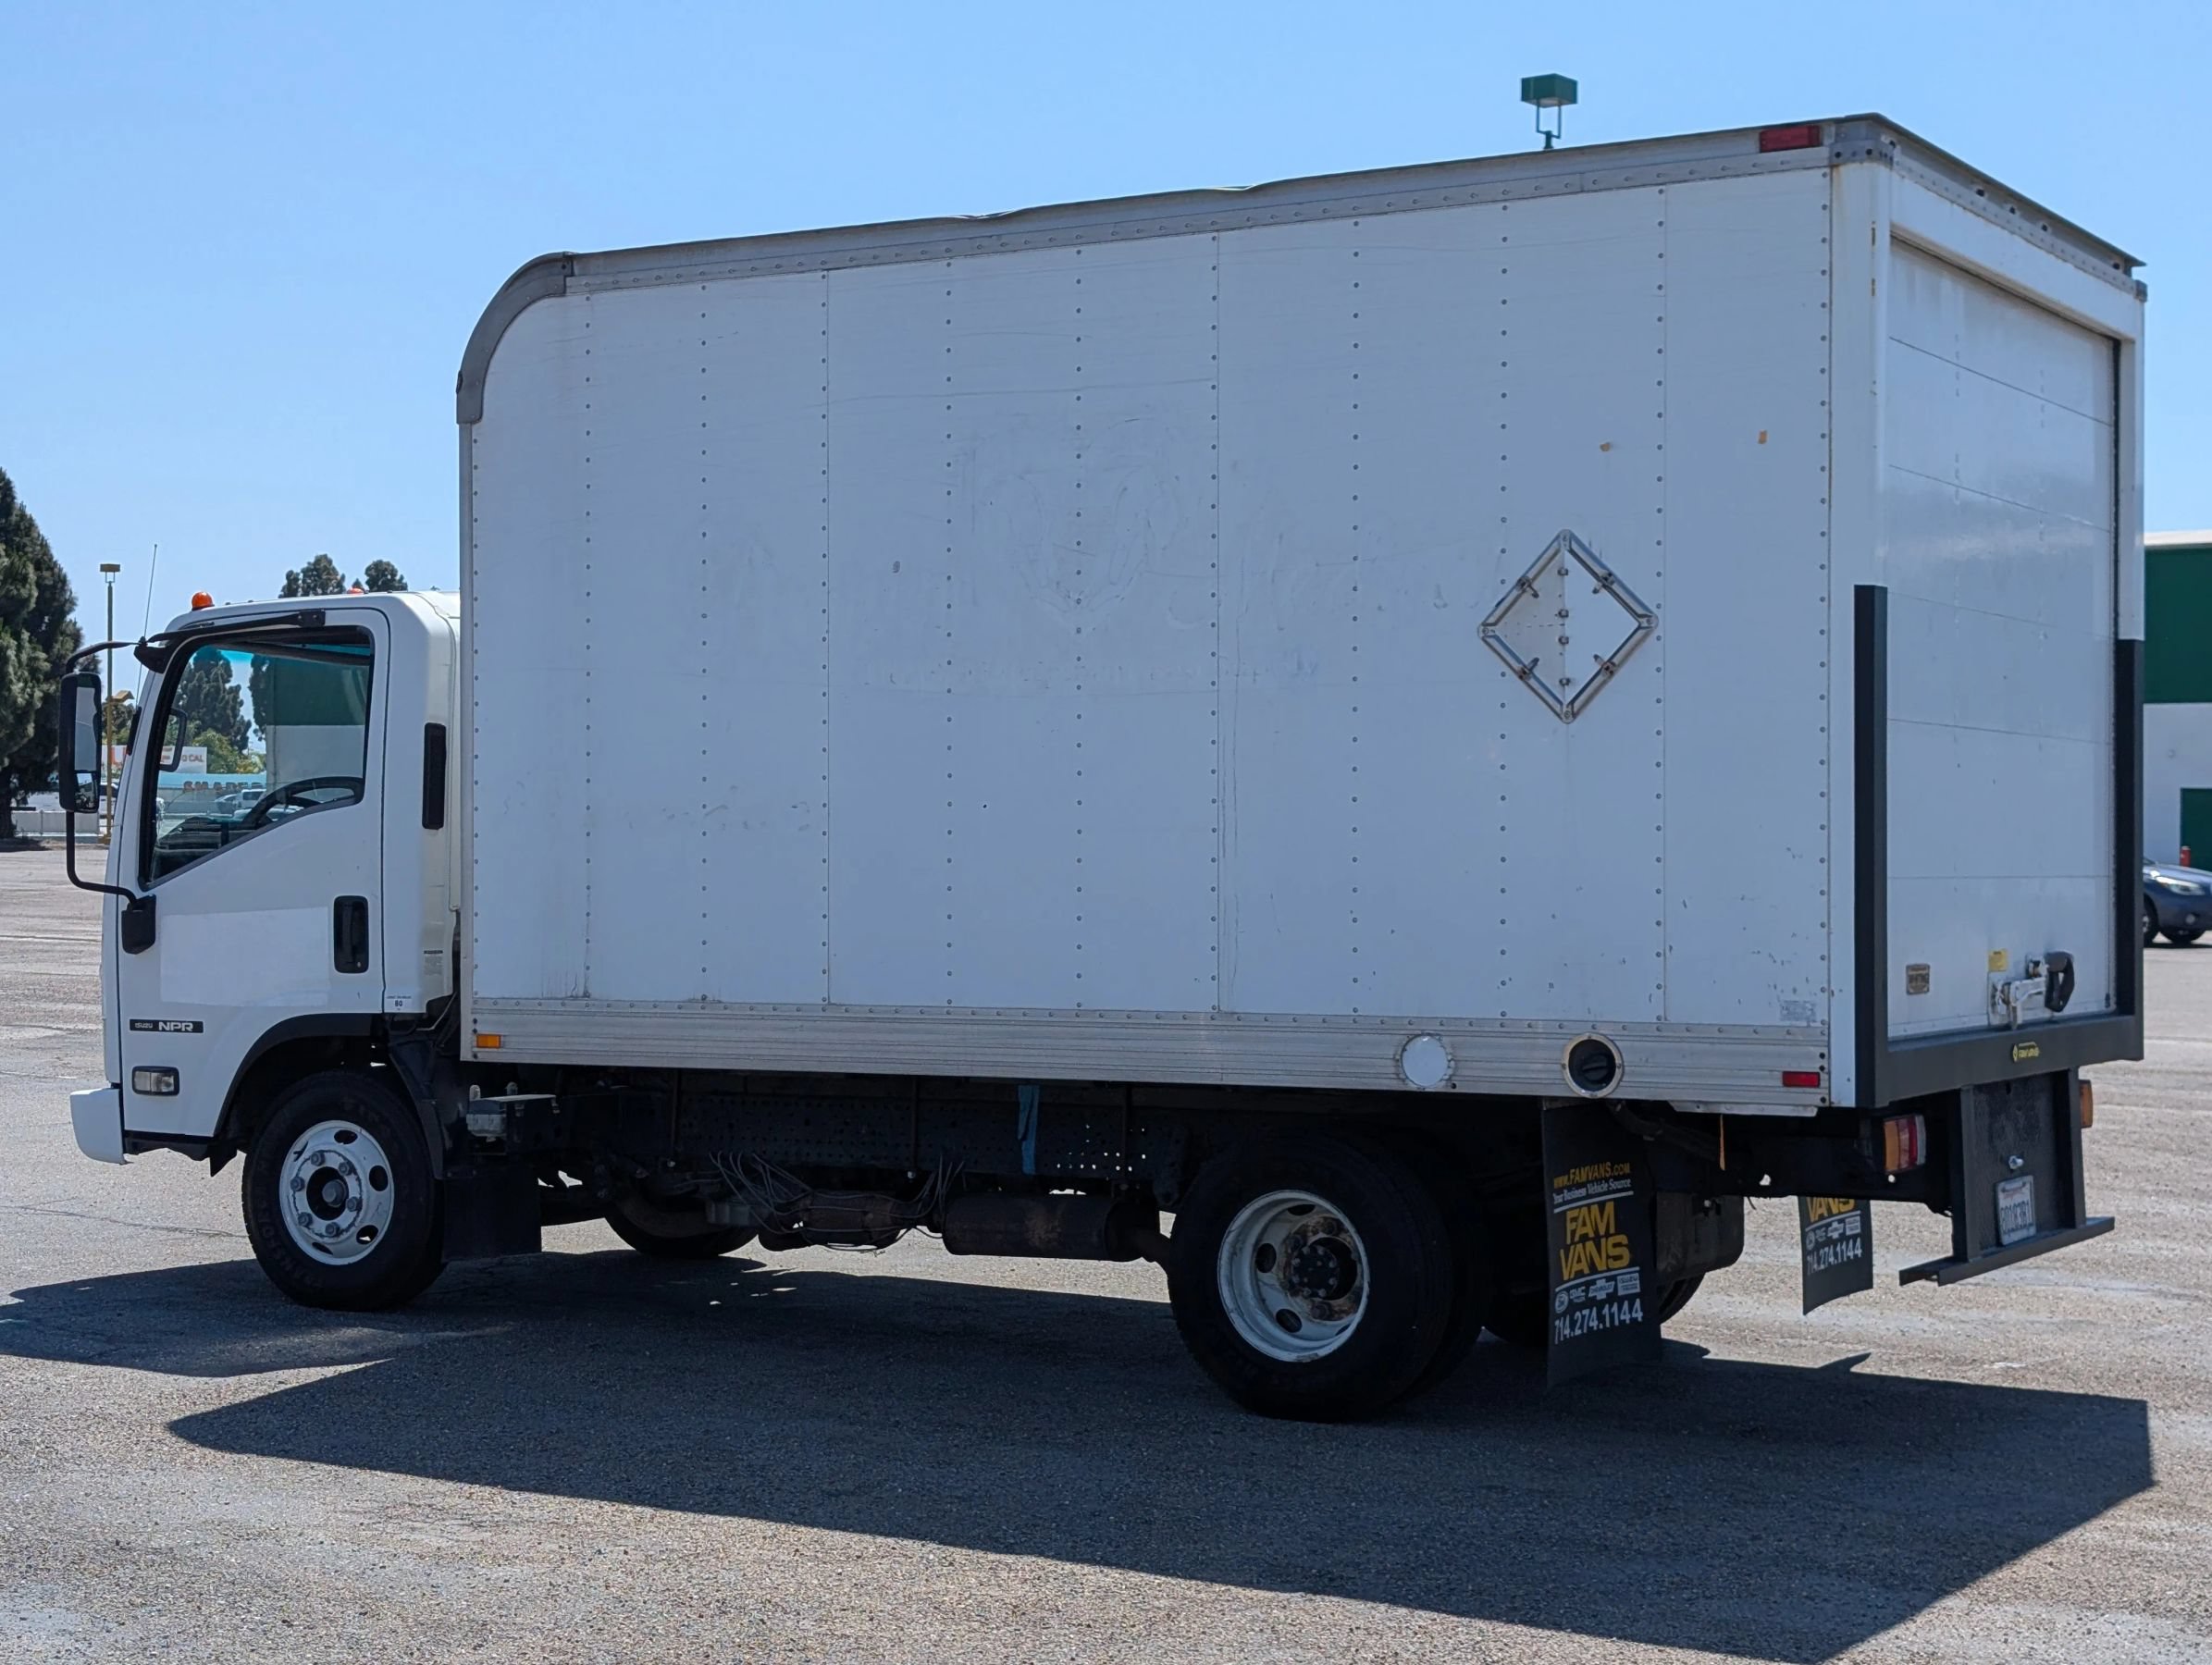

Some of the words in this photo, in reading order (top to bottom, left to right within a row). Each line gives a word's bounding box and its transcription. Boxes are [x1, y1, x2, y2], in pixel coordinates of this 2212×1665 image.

[158, 1021, 193, 1032] NPR
[1608, 1178, 1632, 1190] Source
[1565, 1200, 1616, 1246] FAM
[1559, 1233, 1631, 1281] VANS
[1554, 1298, 1644, 1345] 714.274.1144
